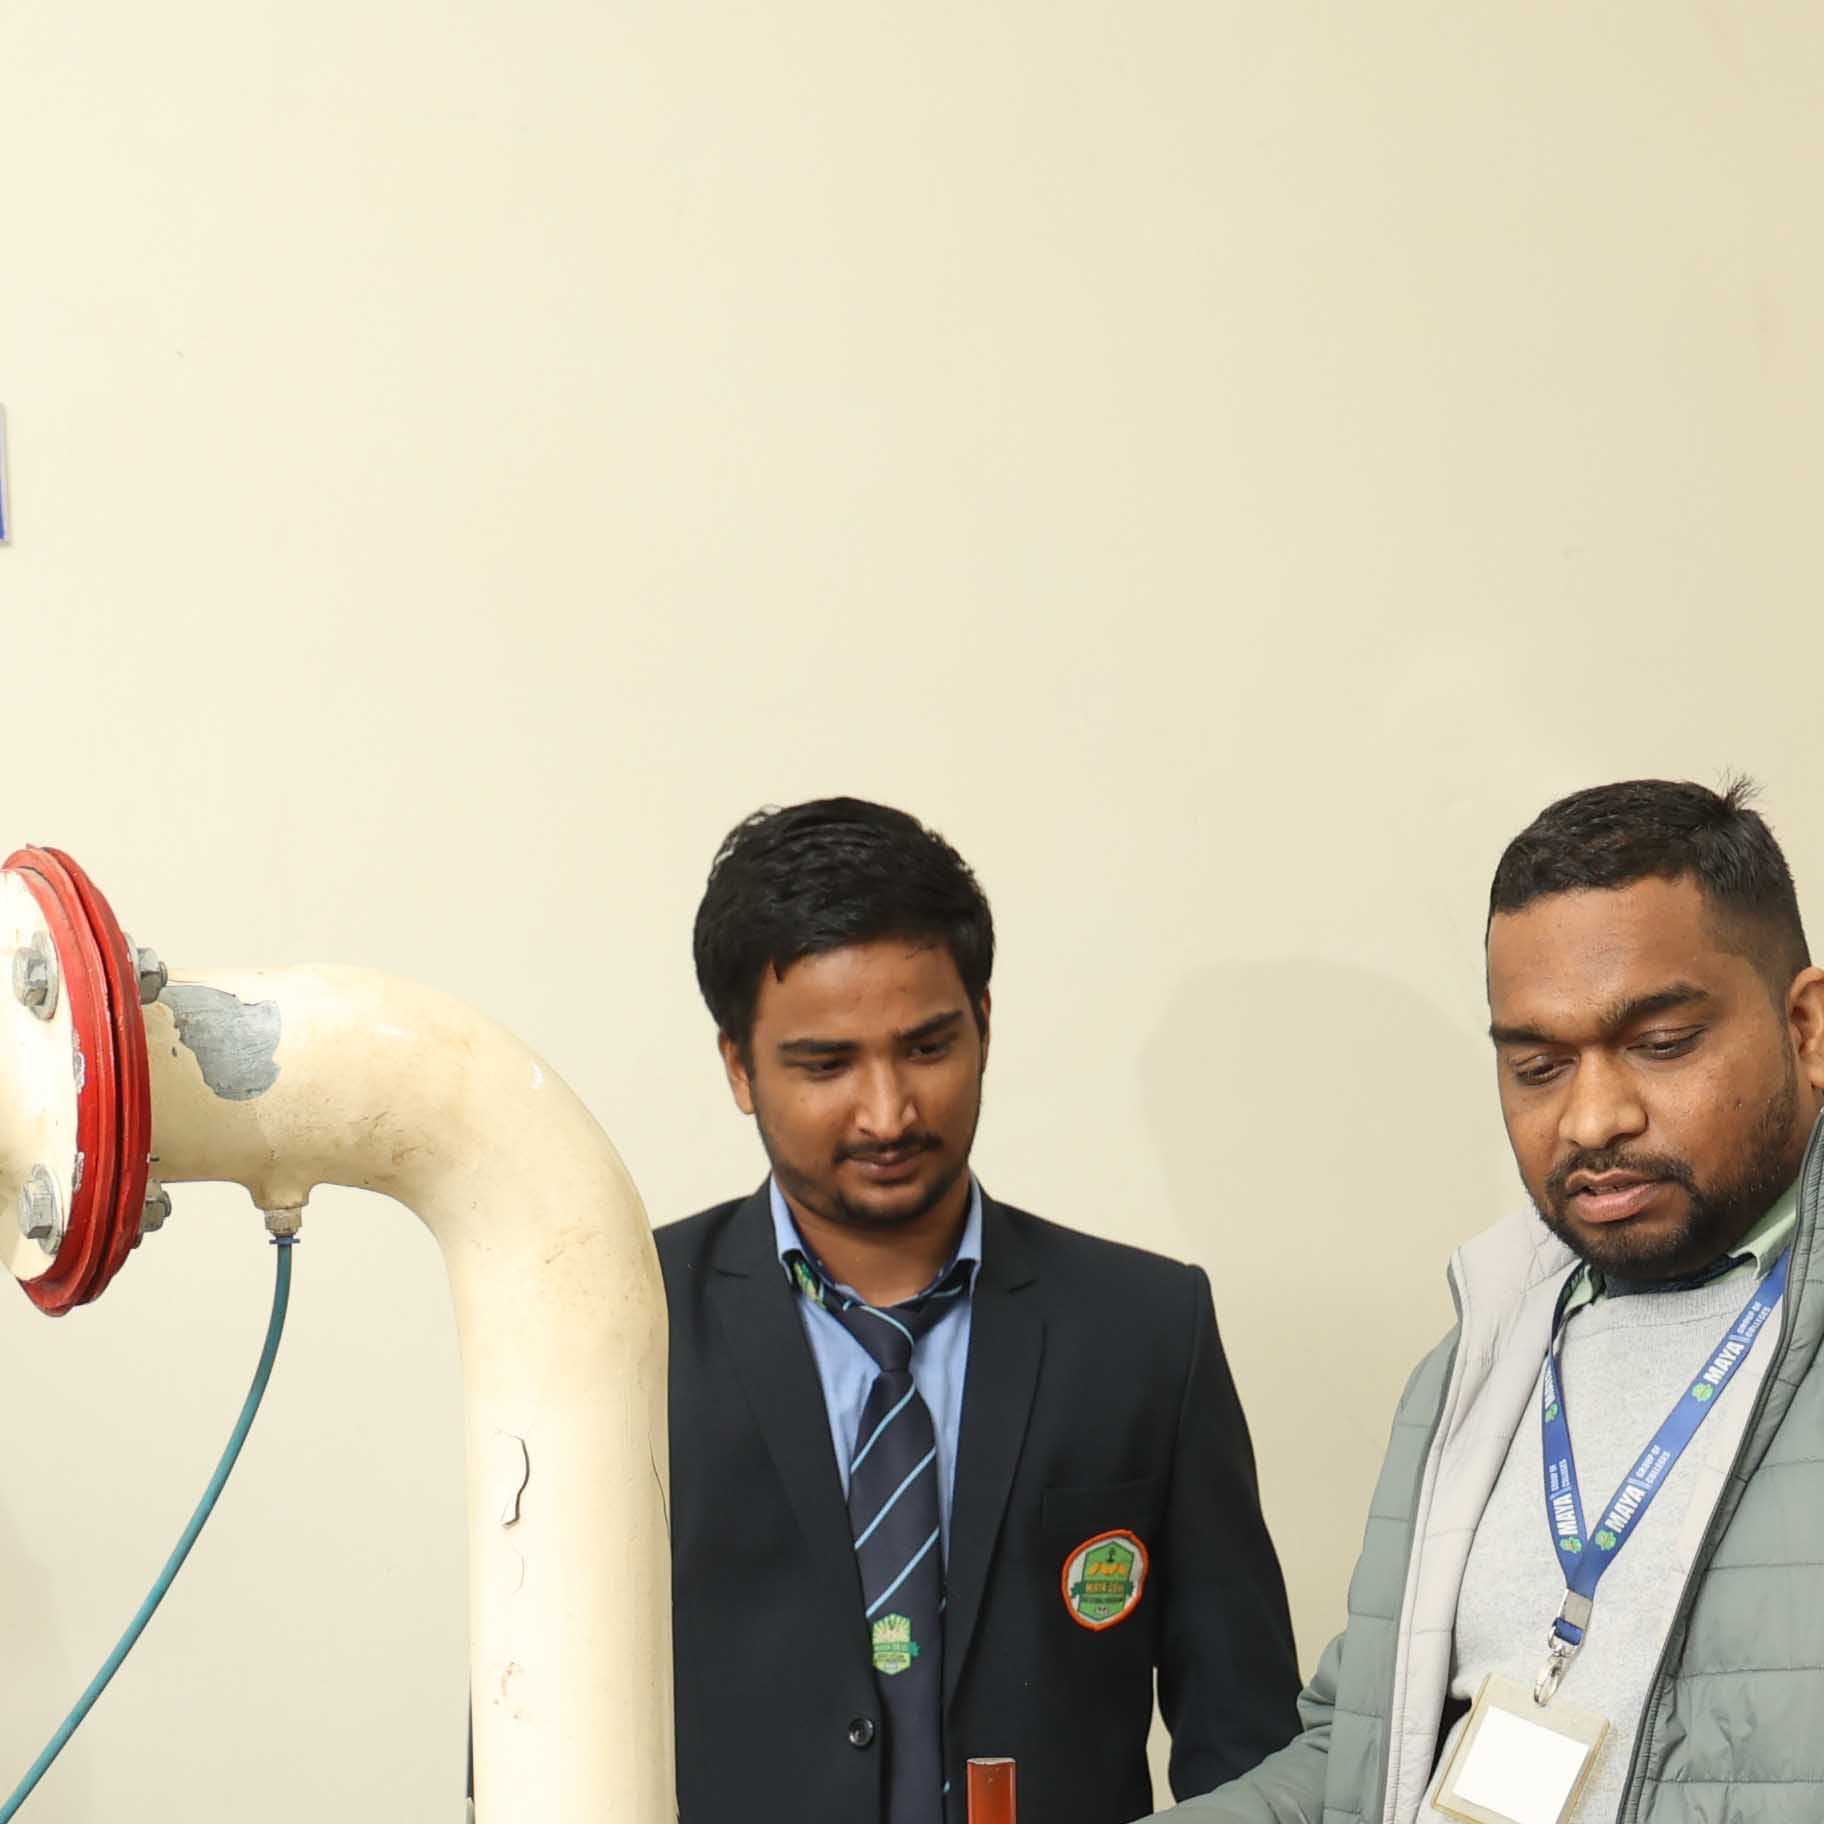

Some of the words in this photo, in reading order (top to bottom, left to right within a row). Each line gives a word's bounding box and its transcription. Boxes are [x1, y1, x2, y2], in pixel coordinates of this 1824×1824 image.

[1703, 1341, 1745, 1385] MAYA
[1552, 1493, 1578, 1536] MAYA
[1604, 1484, 1647, 1534] MAYA
